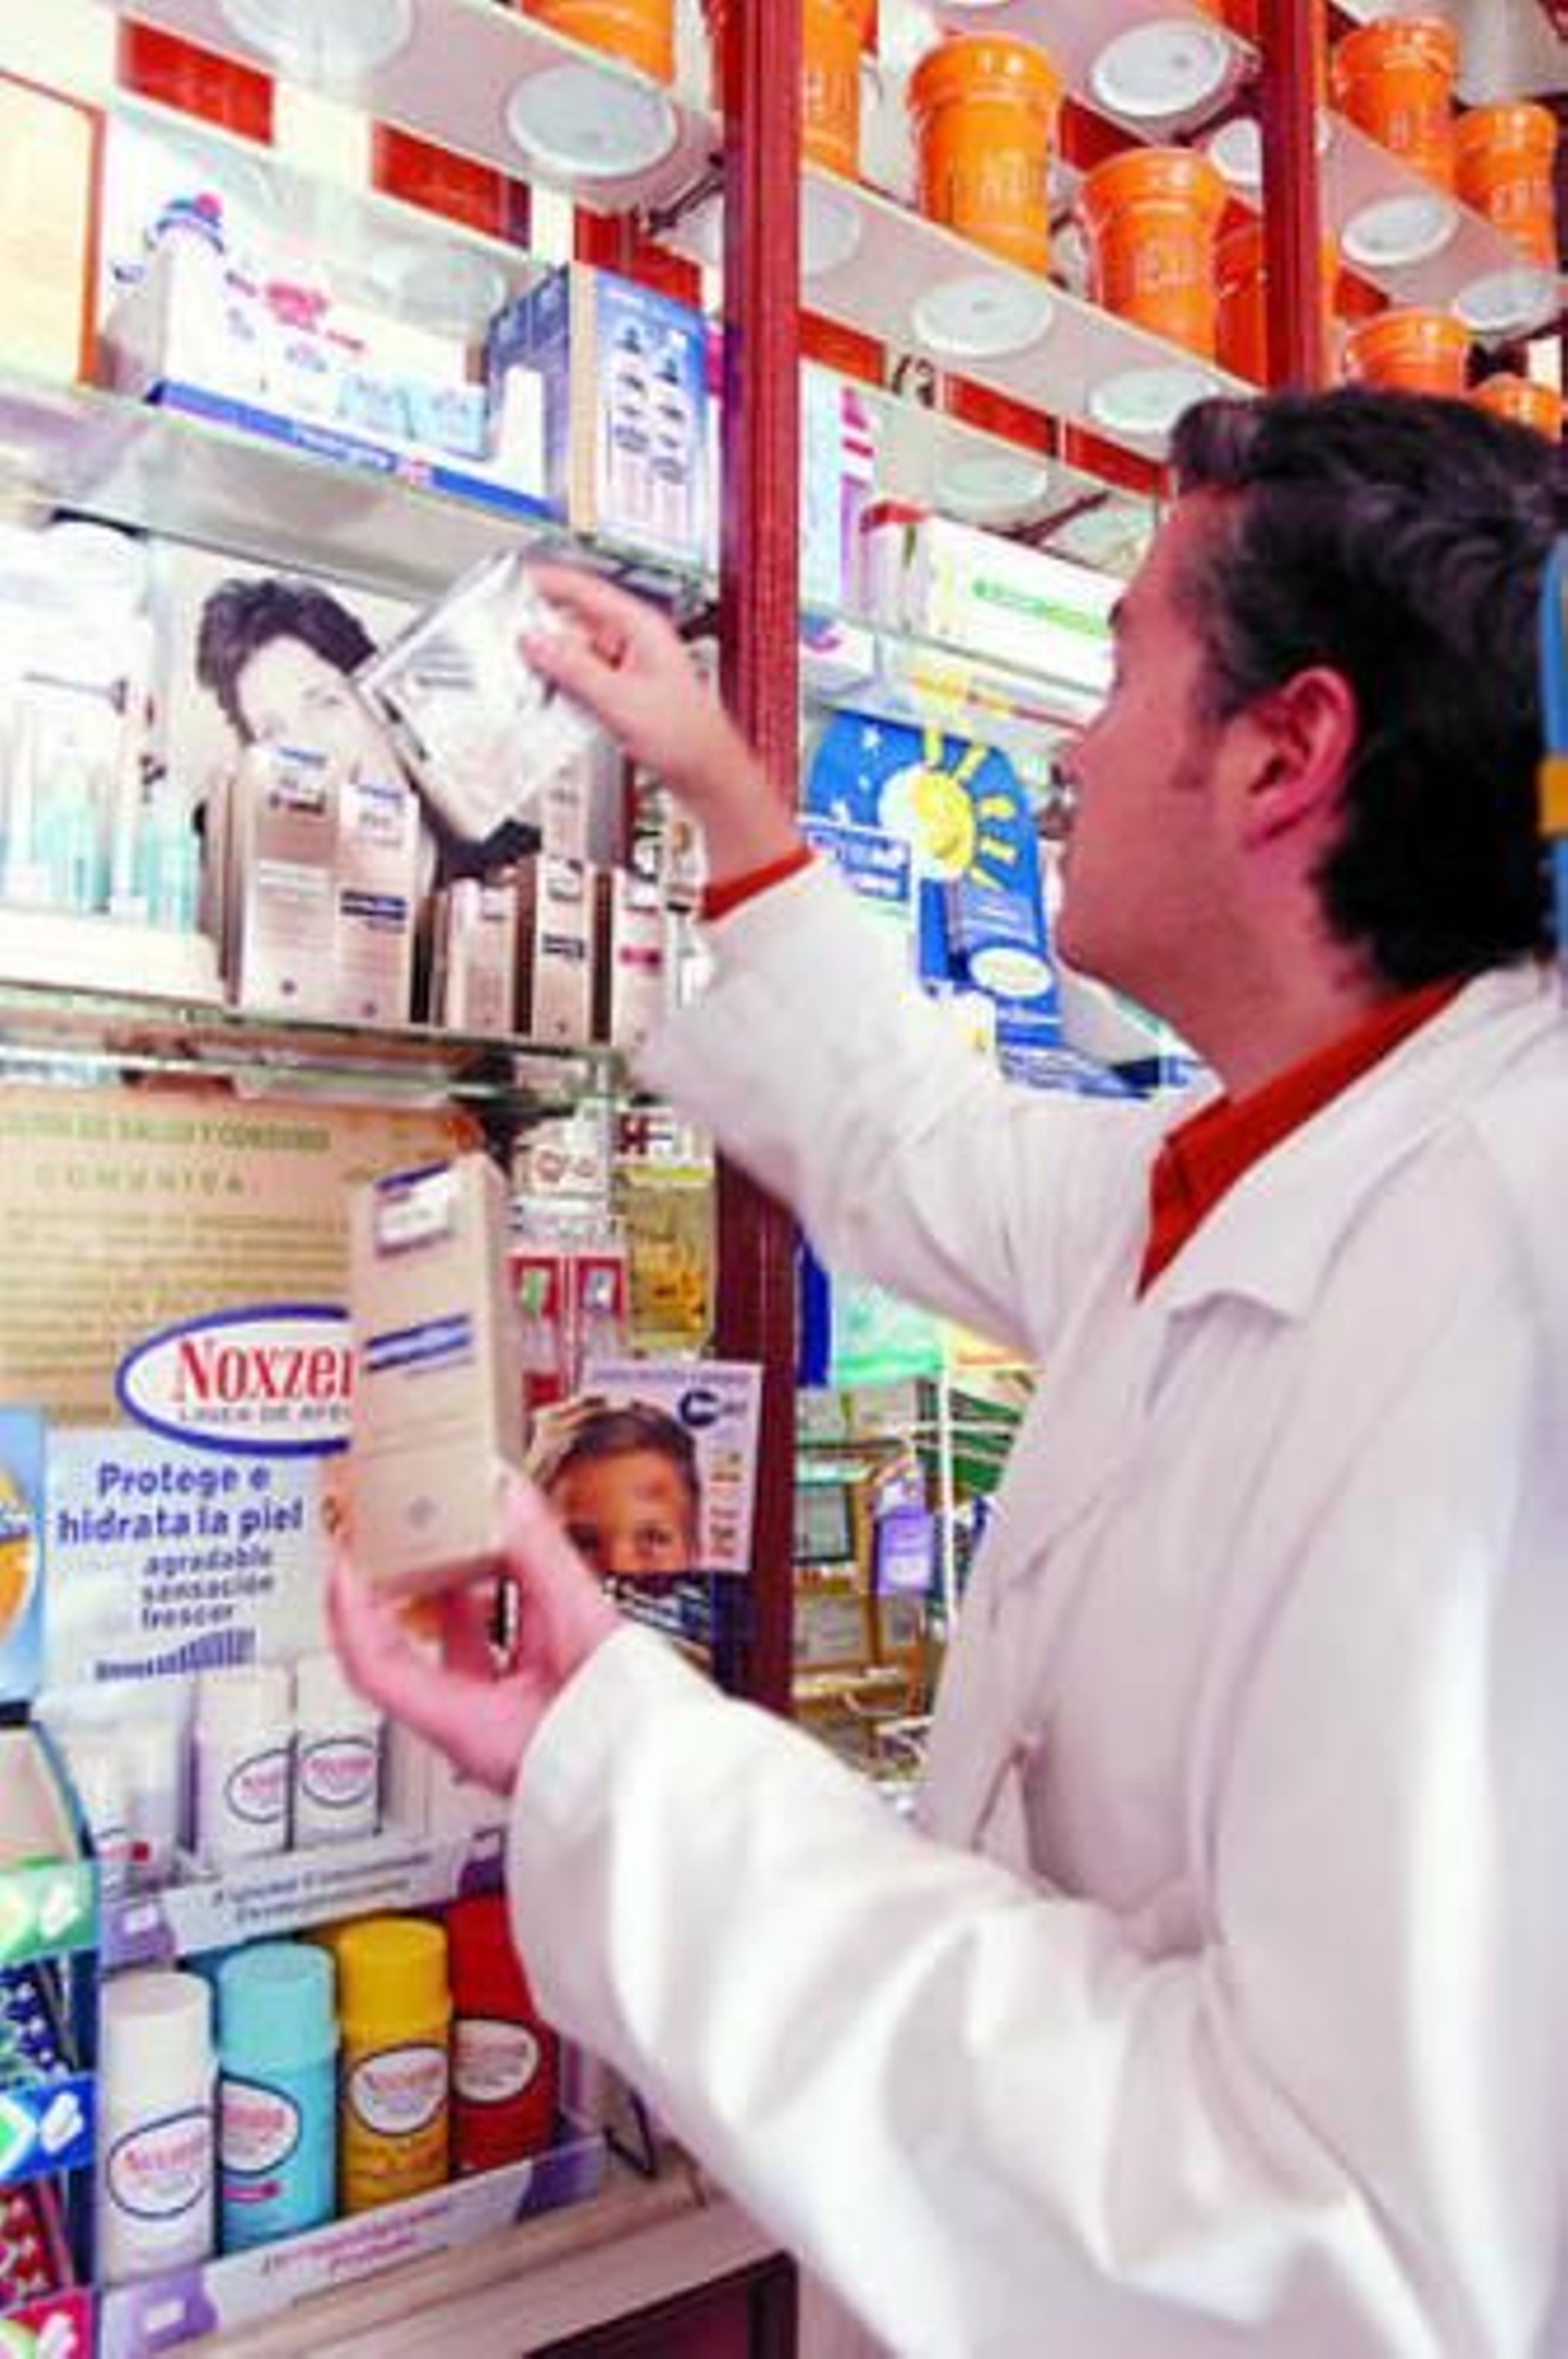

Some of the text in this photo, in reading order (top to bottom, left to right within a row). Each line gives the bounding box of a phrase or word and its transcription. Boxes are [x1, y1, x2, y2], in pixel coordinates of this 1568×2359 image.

[99, 1464, 270, 1499] Protege e
[57, 1508, 191, 1544] hidrata
[198, 1506, 228, 1535] la
[241, 1497, 303, 1539] piel
[144, 1545, 271, 1577] agradable
[141, 1603, 234, 1630] frescor
